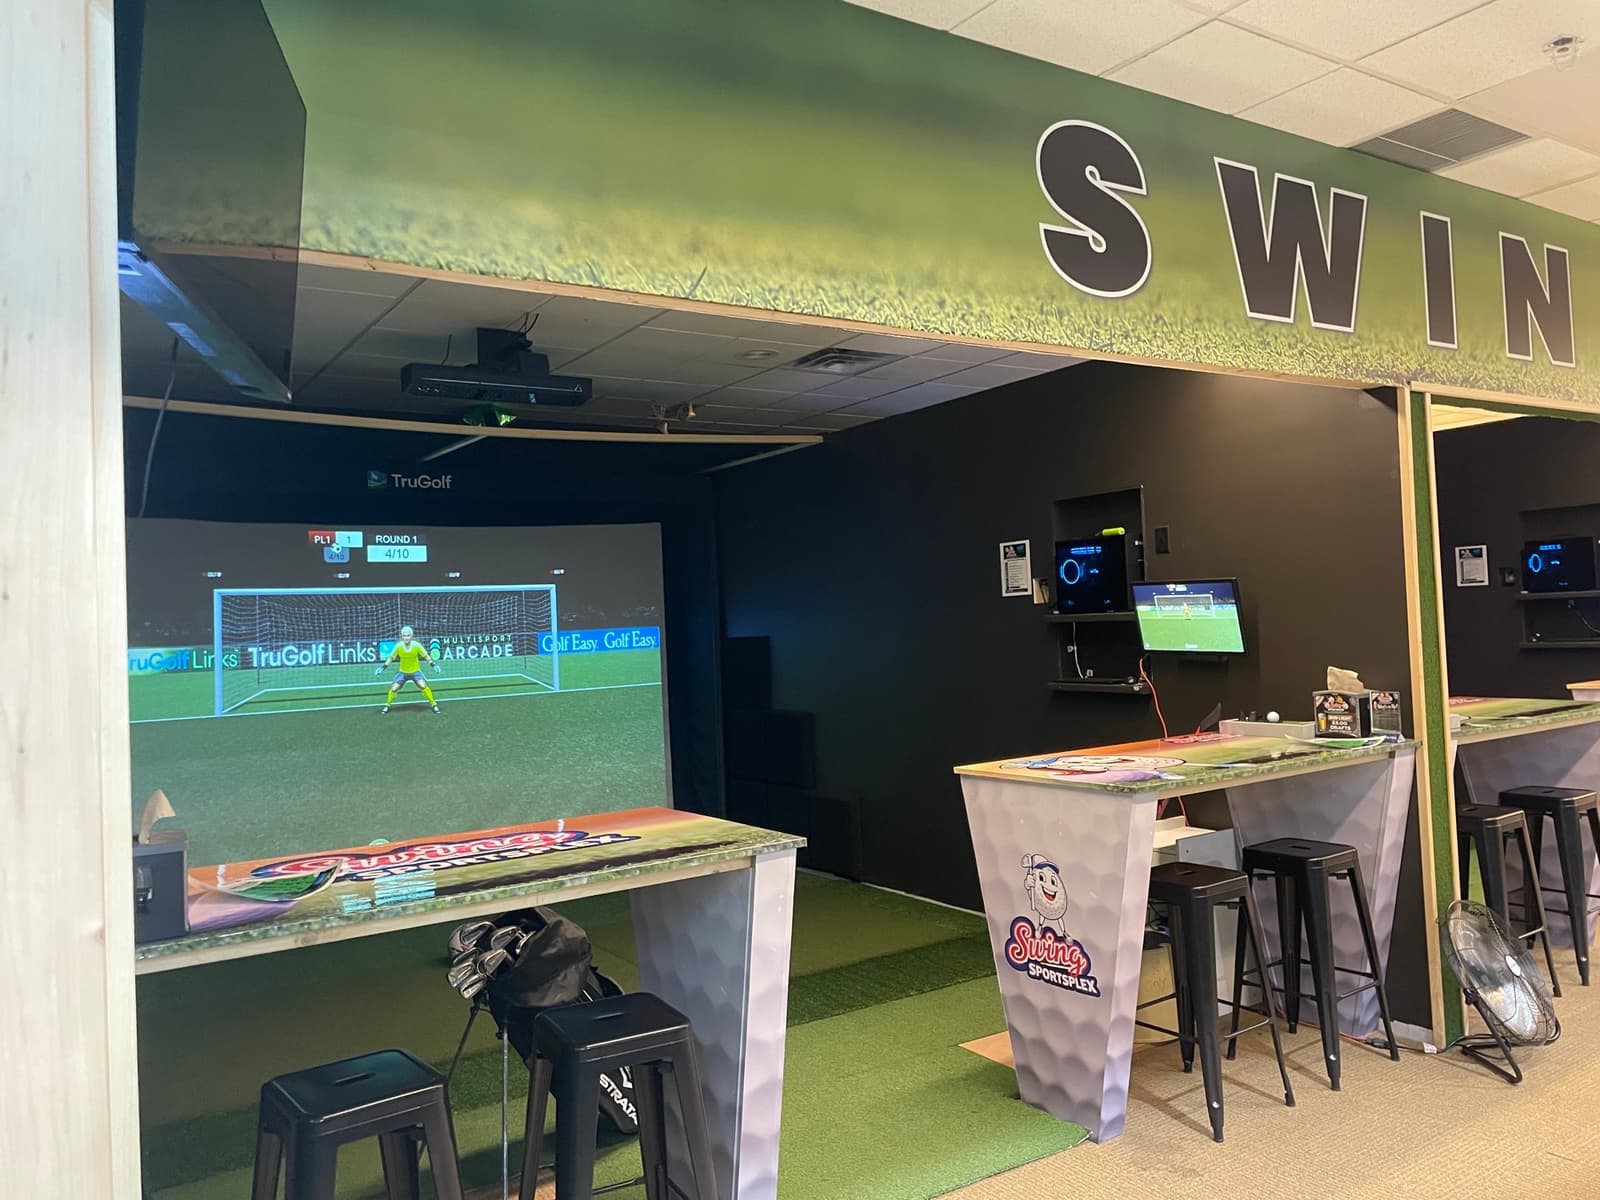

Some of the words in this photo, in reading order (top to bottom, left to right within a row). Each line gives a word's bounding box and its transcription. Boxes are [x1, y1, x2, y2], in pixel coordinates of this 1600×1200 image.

[391, 473, 452, 489] TruGolf
[314, 535, 331, 544] PL1
[375, 535, 411, 544] ROUND
[412, 535, 418, 544] 1
[384, 549, 410, 560] 4/10
[443, 634, 512, 644] MULTISPORT
[603, 632, 630, 649] Golf
[247, 643, 326, 668] TruGolf
[328, 641, 377, 664] Links
[443, 643, 513, 660] ARCADE
[128, 649, 190, 672] ruGolf
[356, 834, 633, 879] SPORTSPLEX
[1008, 921, 1087, 977] Swing
[1028, 961, 1098, 994] SPORTSPLEX
